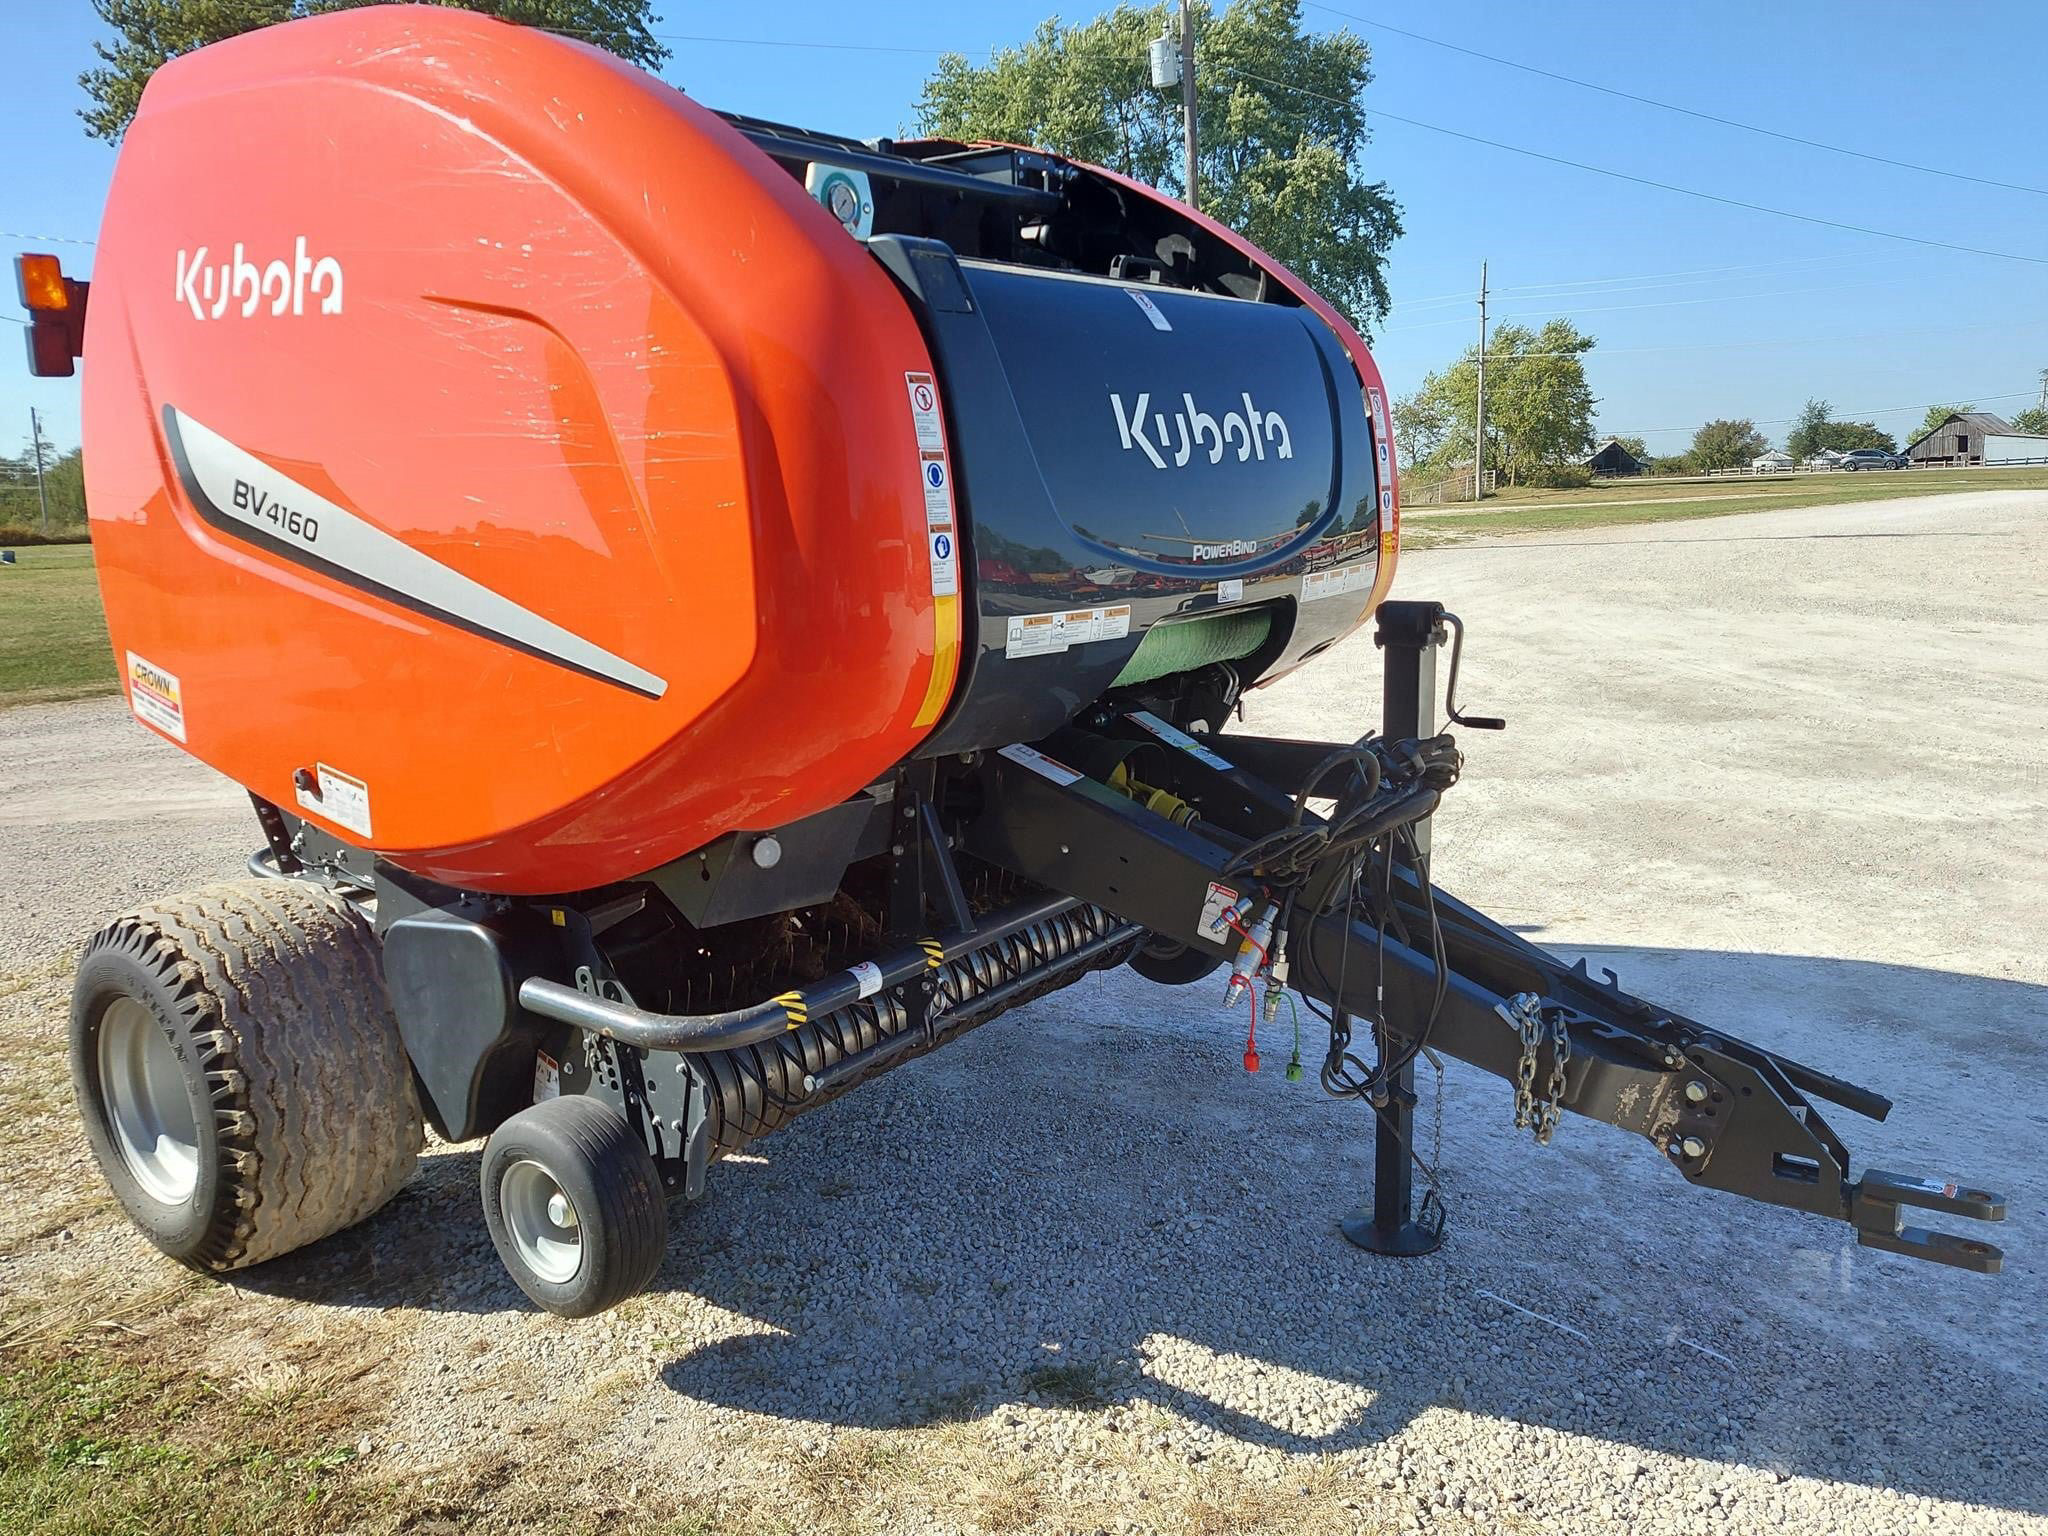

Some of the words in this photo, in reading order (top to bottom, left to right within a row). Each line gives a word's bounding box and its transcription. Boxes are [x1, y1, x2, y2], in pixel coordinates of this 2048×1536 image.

[175, 235, 343, 321] Kubota
[1109, 392, 1293, 469] Kubota
[232, 478, 318, 543] BV4160
[135, 663, 170, 696] CROWN
